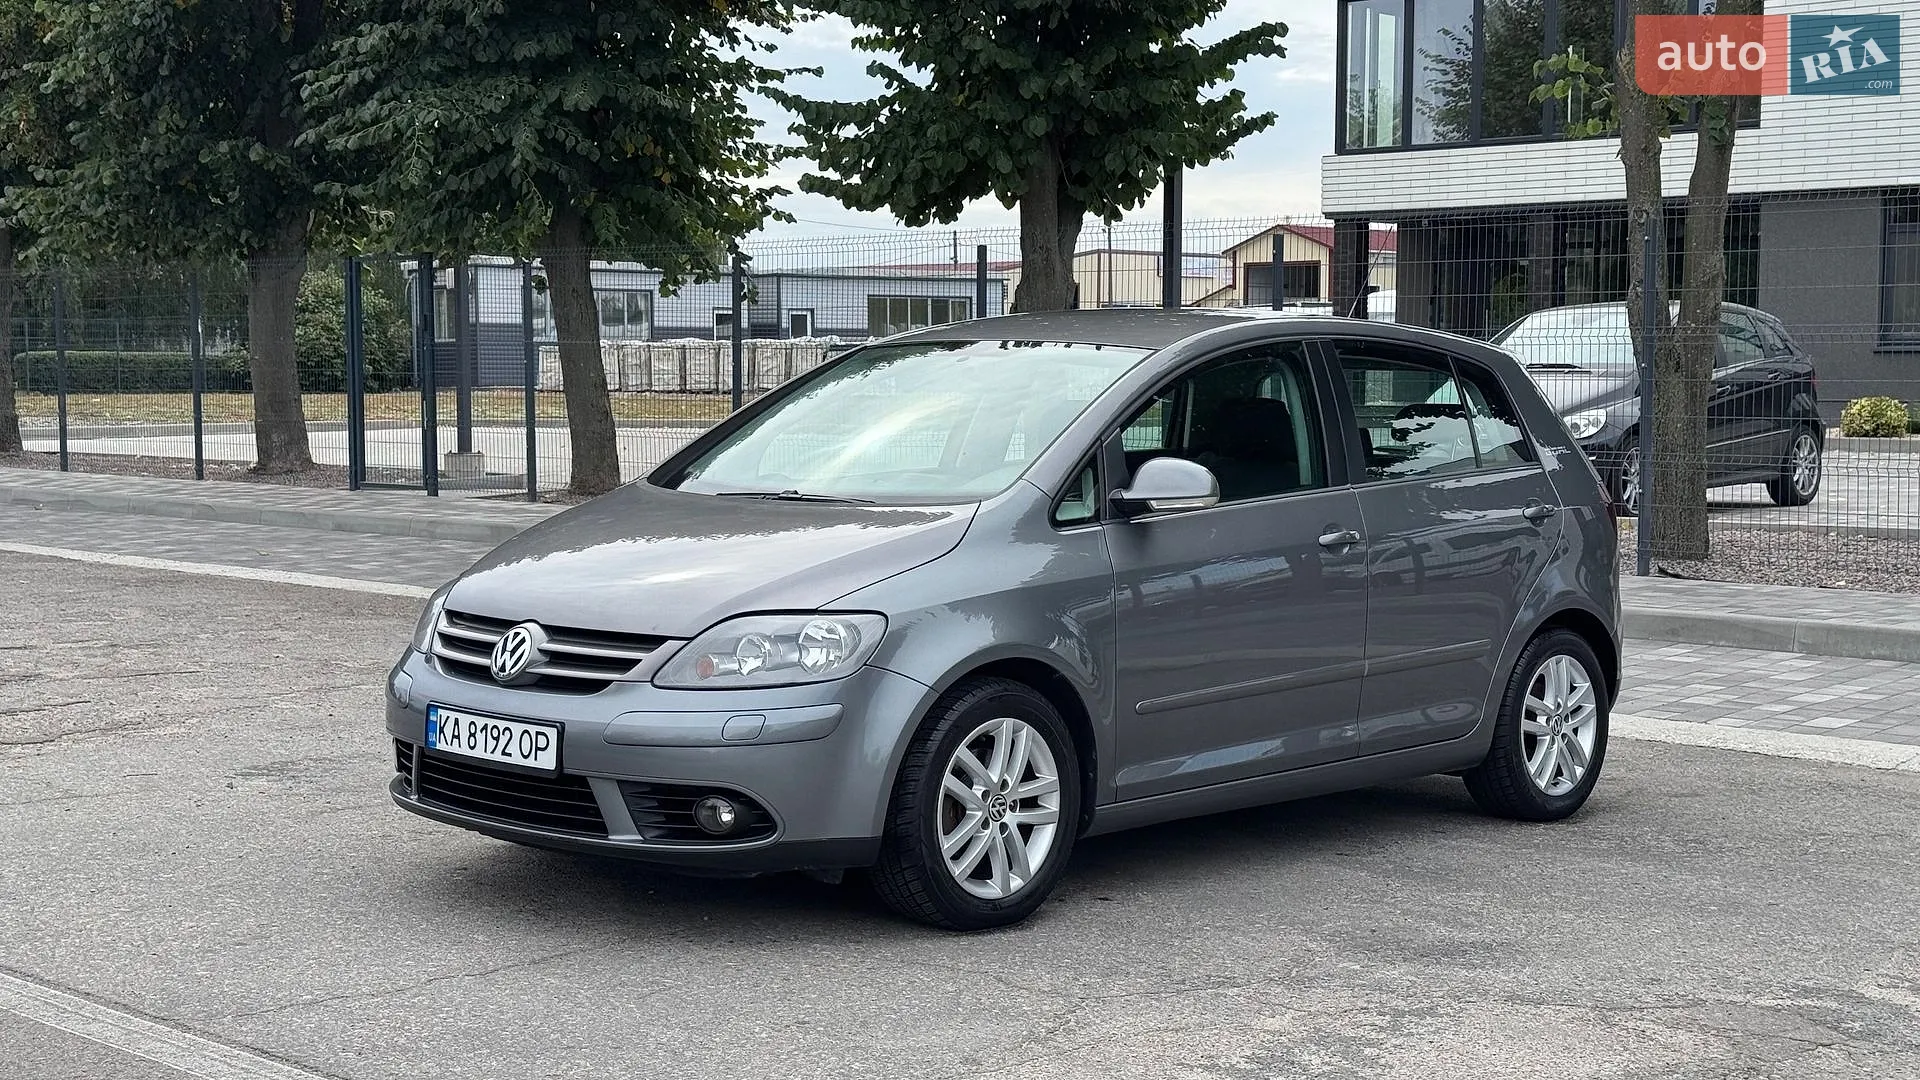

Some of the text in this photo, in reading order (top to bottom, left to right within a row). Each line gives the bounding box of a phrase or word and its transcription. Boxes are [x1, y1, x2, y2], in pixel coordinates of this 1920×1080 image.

[438, 713, 550, 761] KA 8192 OP
